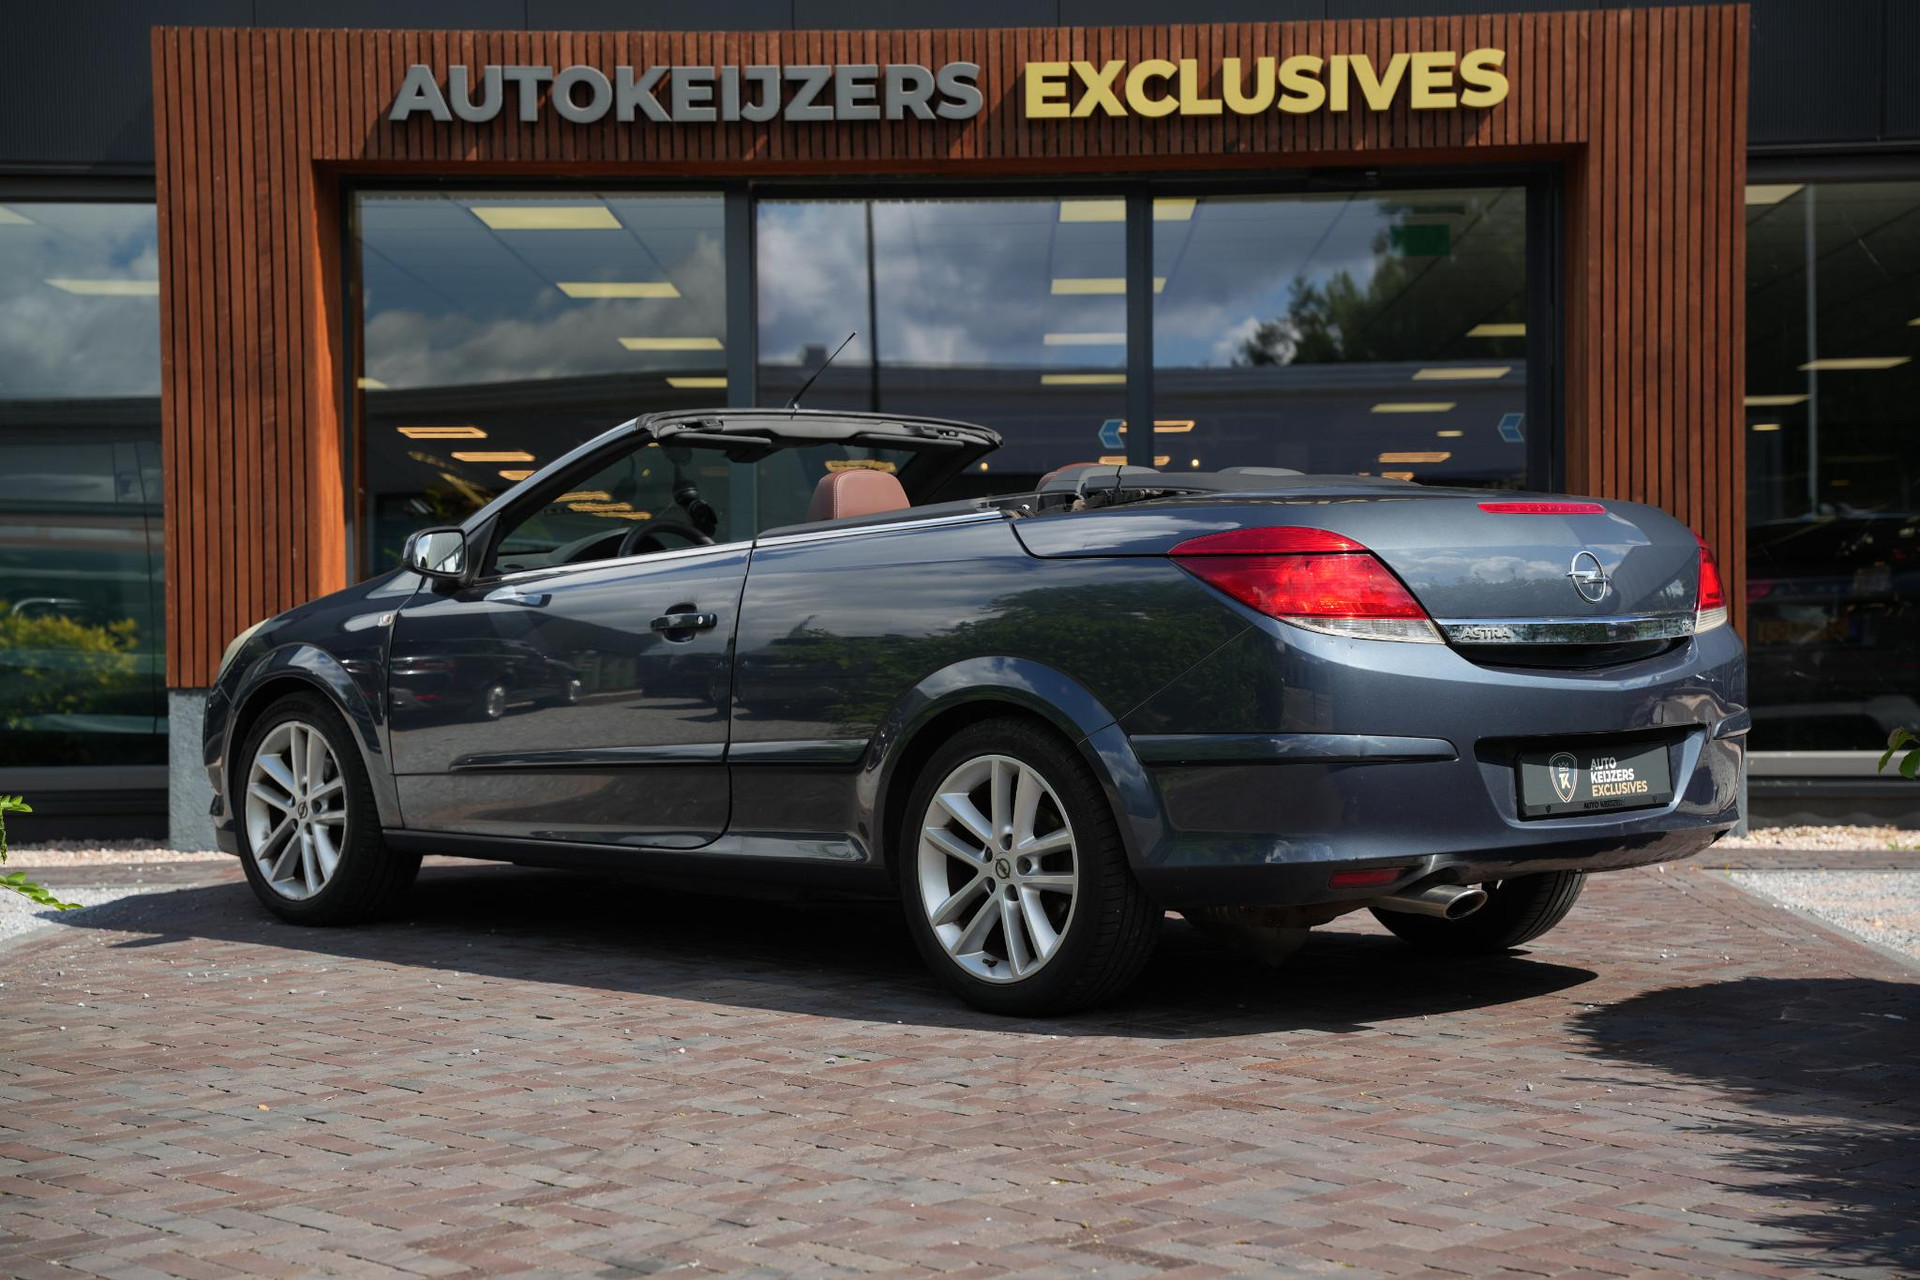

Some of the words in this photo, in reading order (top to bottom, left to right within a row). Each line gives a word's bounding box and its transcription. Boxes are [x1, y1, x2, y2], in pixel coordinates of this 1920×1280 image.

[388, 61, 984, 124] AUTOKEIJZERS
[1025, 48, 1510, 119] EXCLUSIVES
[1460, 627, 1512, 640] ASTRA
[1590, 757, 1617, 771] AUTO
[1590, 768, 1635, 784] KEIJZERS
[1592, 780, 1648, 797] EXCLUSIVES
